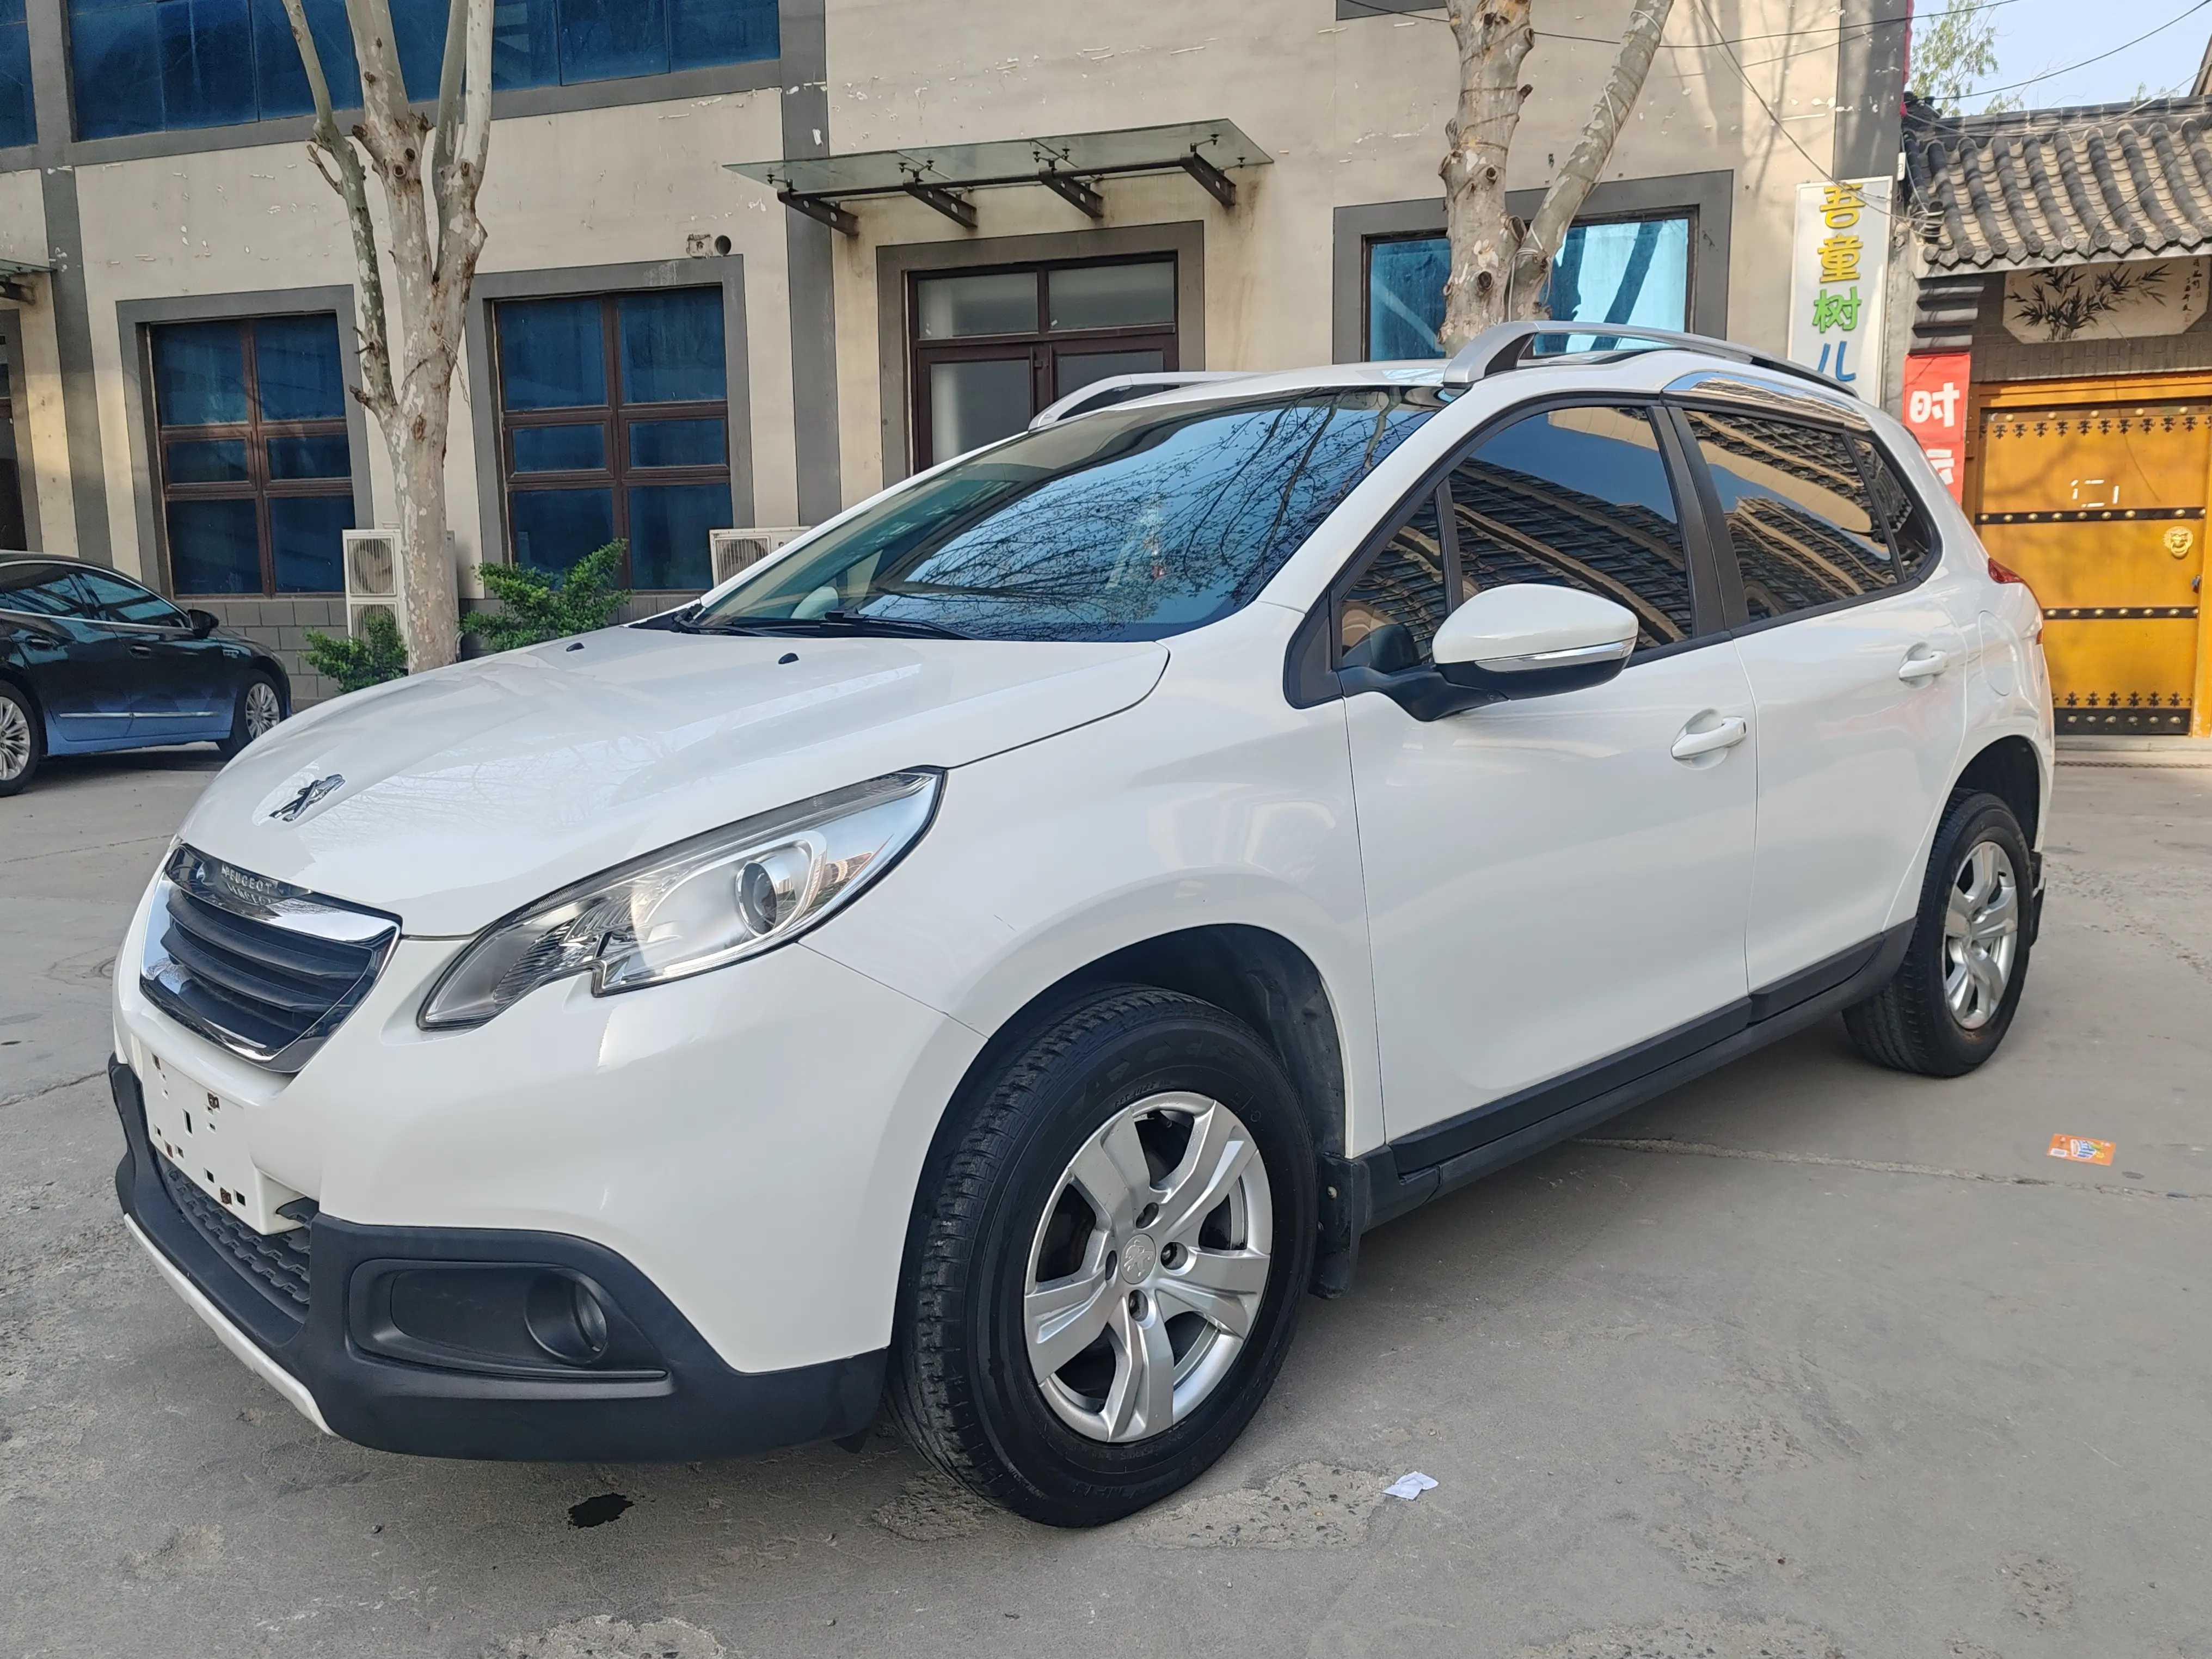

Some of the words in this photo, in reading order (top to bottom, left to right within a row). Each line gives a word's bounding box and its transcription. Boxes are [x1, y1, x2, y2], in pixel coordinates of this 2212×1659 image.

[1812, 183, 1866, 382] 吾童树儿
[224, 865, 272, 894] PEUGEOT
